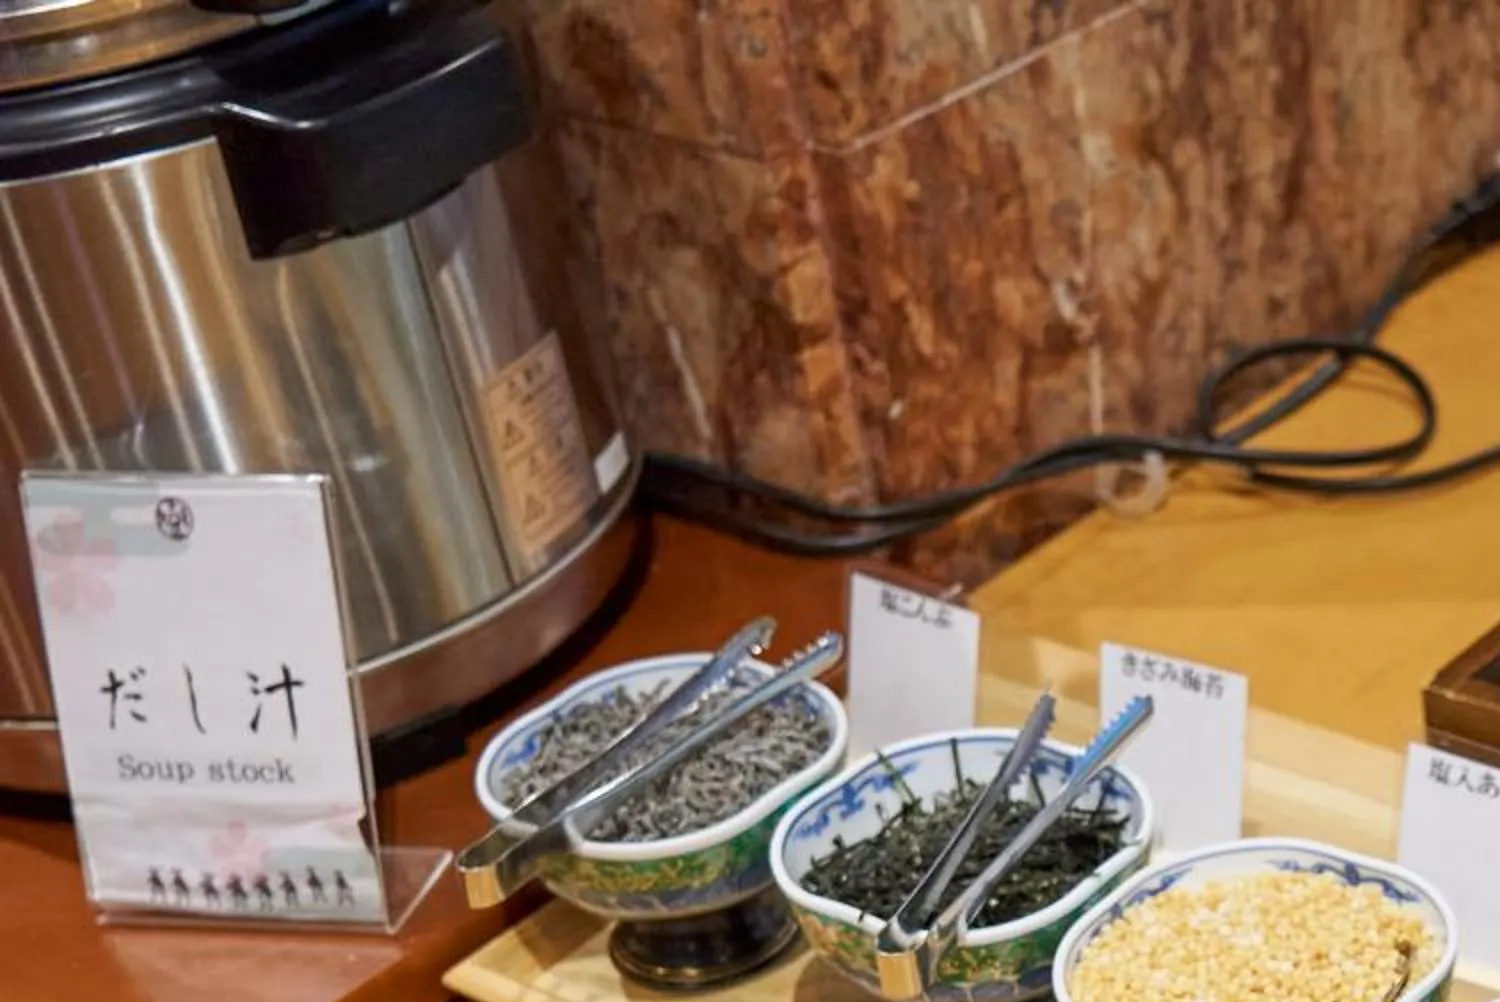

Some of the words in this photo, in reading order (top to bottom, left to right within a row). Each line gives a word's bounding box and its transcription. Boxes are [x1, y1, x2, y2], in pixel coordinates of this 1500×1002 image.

[99, 662, 305, 740] だし汁
[117, 753, 195, 784] Soup
[207, 757, 296, 784] stock
